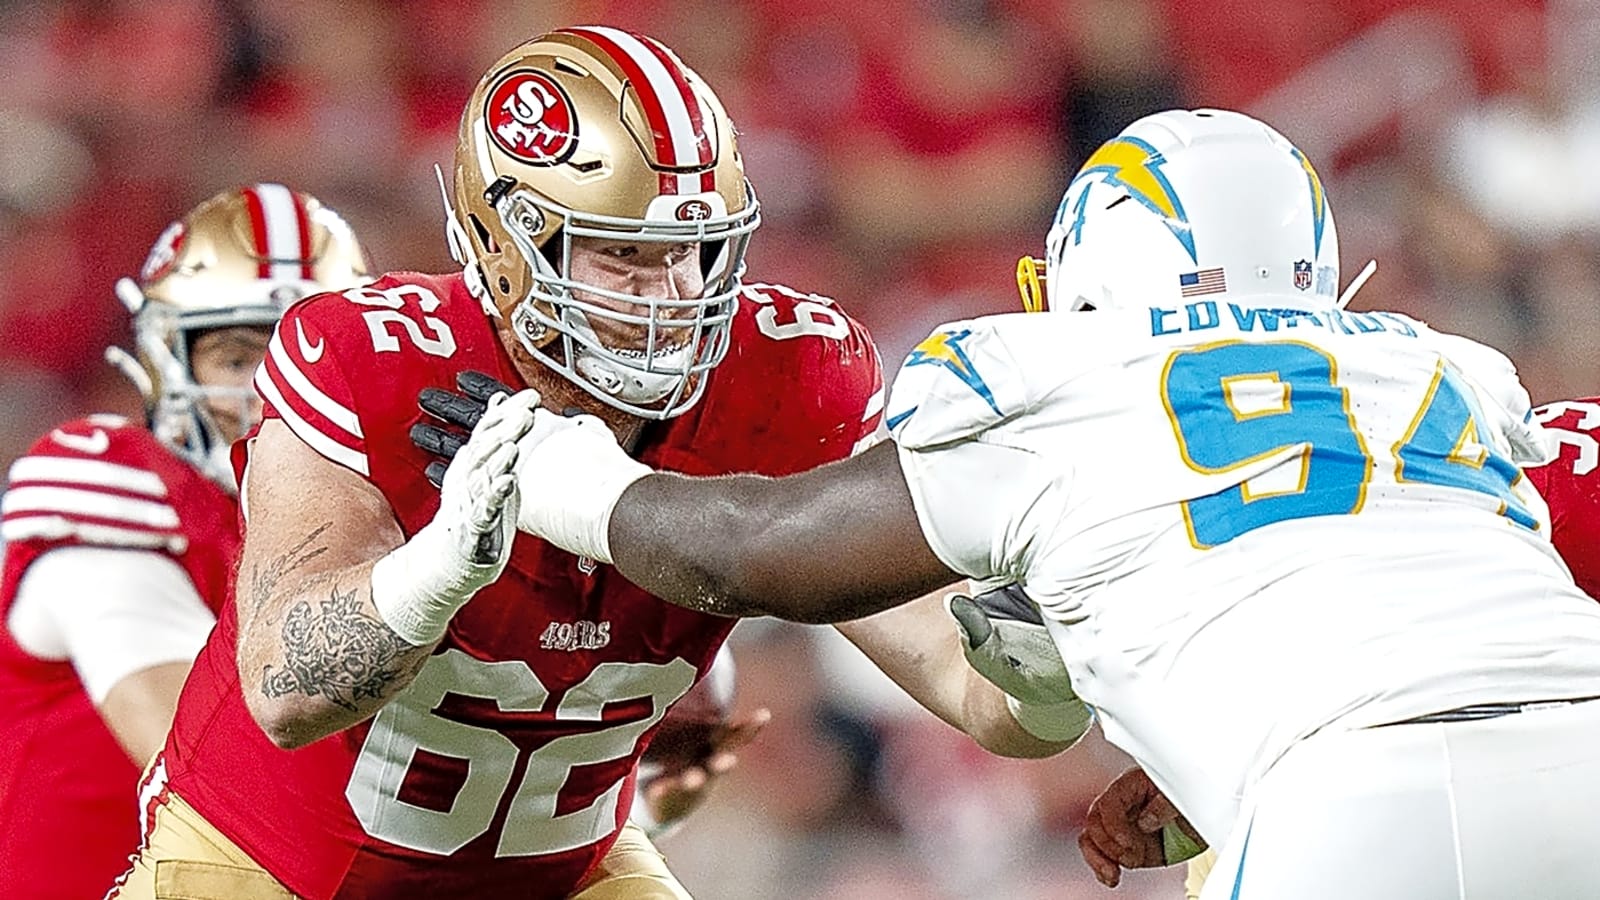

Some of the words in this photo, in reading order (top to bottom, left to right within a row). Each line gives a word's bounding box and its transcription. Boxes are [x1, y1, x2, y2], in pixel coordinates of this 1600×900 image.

[341, 284, 458, 359] 62
[1160, 339, 1541, 550] 94
[345, 648, 698, 859] 62
